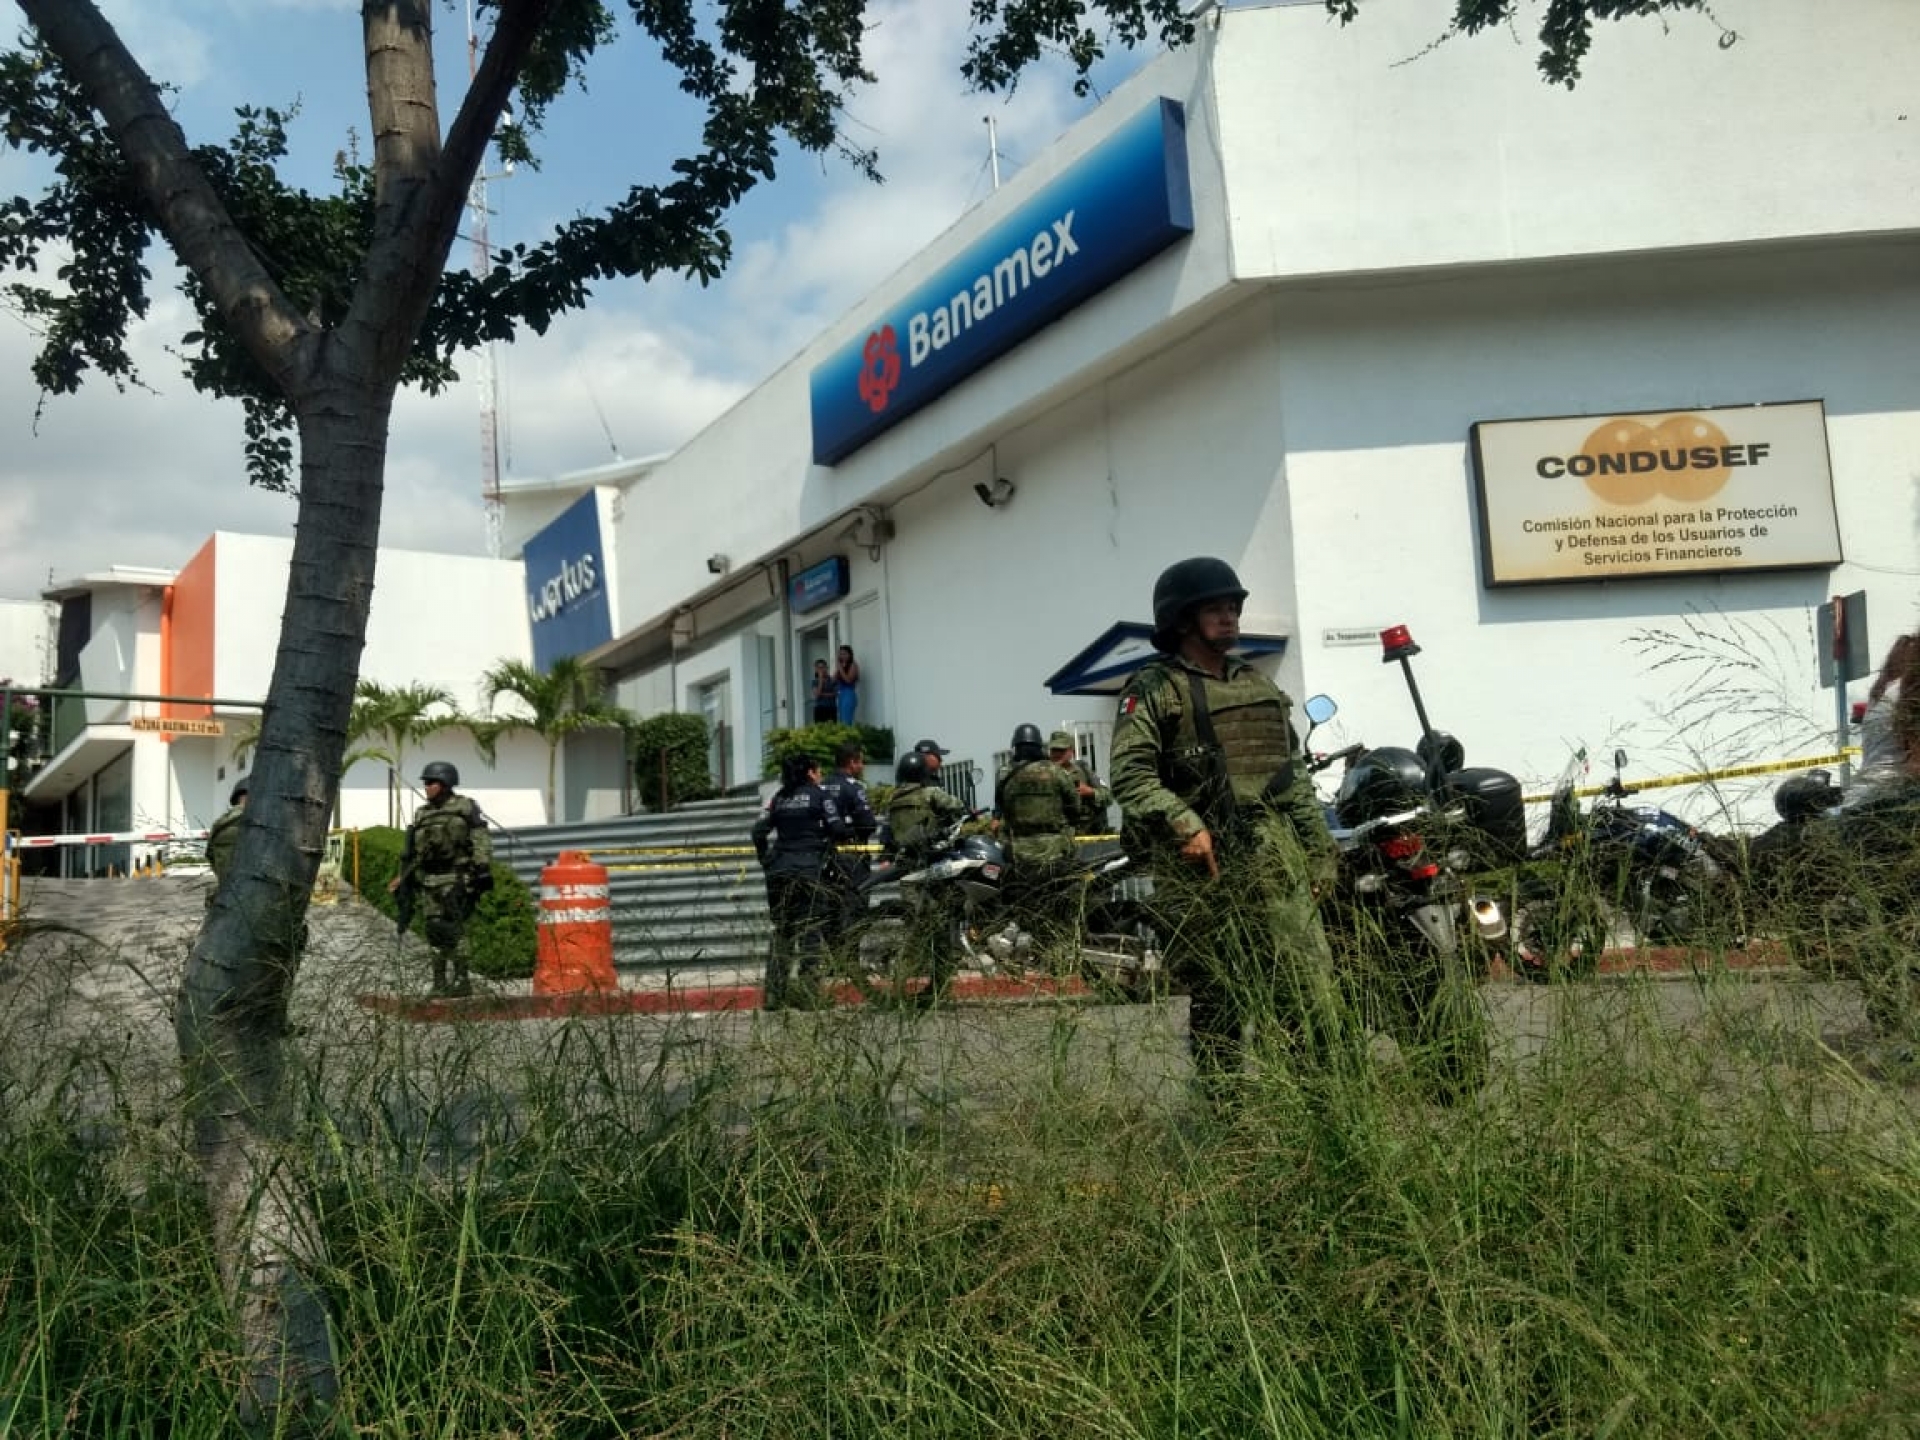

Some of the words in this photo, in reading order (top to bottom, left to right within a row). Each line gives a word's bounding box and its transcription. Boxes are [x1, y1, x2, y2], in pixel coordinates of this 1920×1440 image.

[909, 210, 1079, 367] Banamex
[1536, 443, 1771, 479] CONDUSEF
[1522, 516, 1592, 533] Comisión
[1596, 511, 1659, 528] Nacional
[1664, 511, 1695, 527] para
[1700, 508, 1713, 522] la
[1717, 504, 1798, 521] Protección
[1555, 538, 1563, 552] y
[1568, 533, 1627, 548] Defensa
[1630, 531, 1648, 545] de
[1653, 529, 1674, 543] los
[1679, 525, 1745, 541] Usuarios
[1750, 524, 1768, 538] de
[1584, 549, 1651, 565] Servicios
[1656, 545, 1742, 561] Financieros
